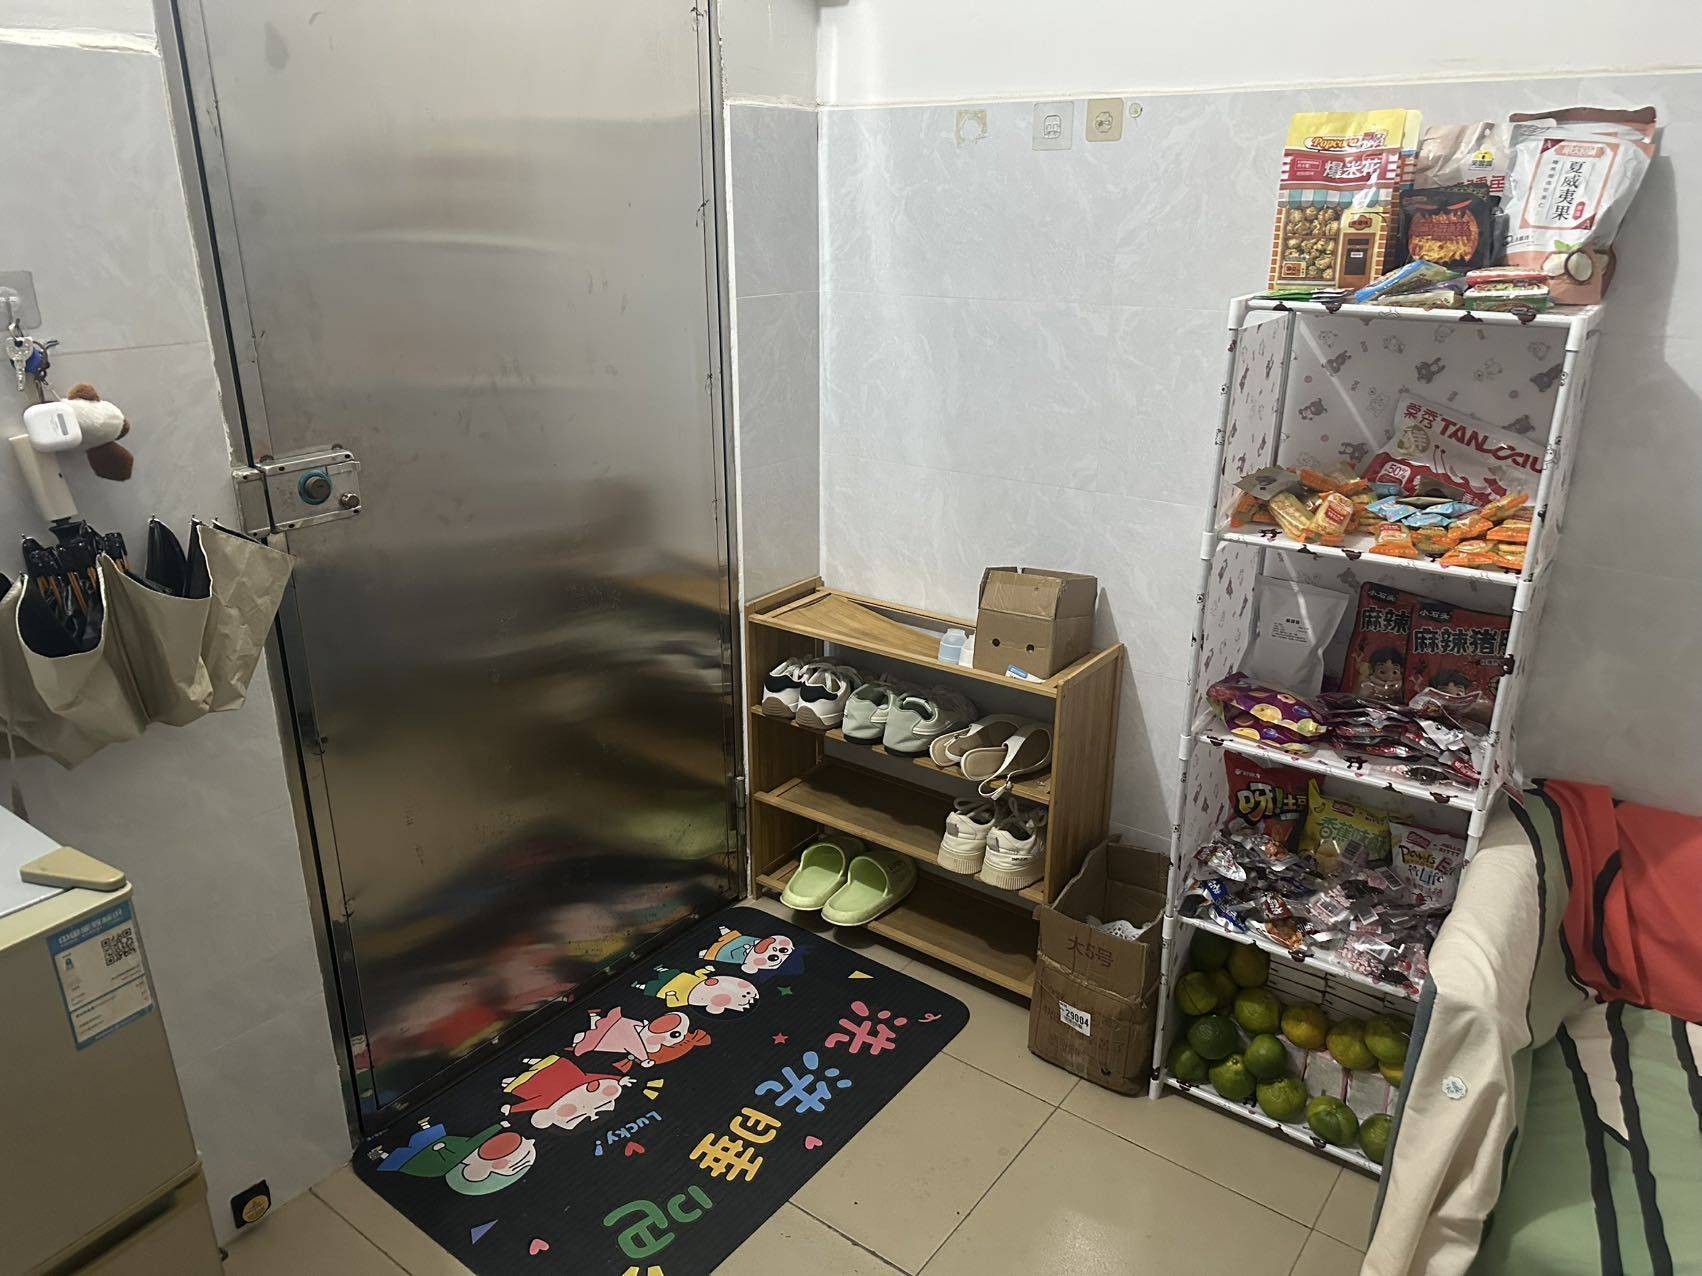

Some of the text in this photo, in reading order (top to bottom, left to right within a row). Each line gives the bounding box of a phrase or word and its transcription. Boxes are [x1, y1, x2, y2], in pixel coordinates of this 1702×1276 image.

[1323, 158, 1381, 178] 爆米花
[1551, 160, 1586, 221] 夏威夷果
[1359, 605, 1409, 635] 麻辣
[1419, 608, 1450, 620] 小石头
[1065, 1008, 1090, 1028] 29004
[594, 1110, 663, 1156] Lucky!
[602, 1000, 909, 1260] 洗洗睡吧
